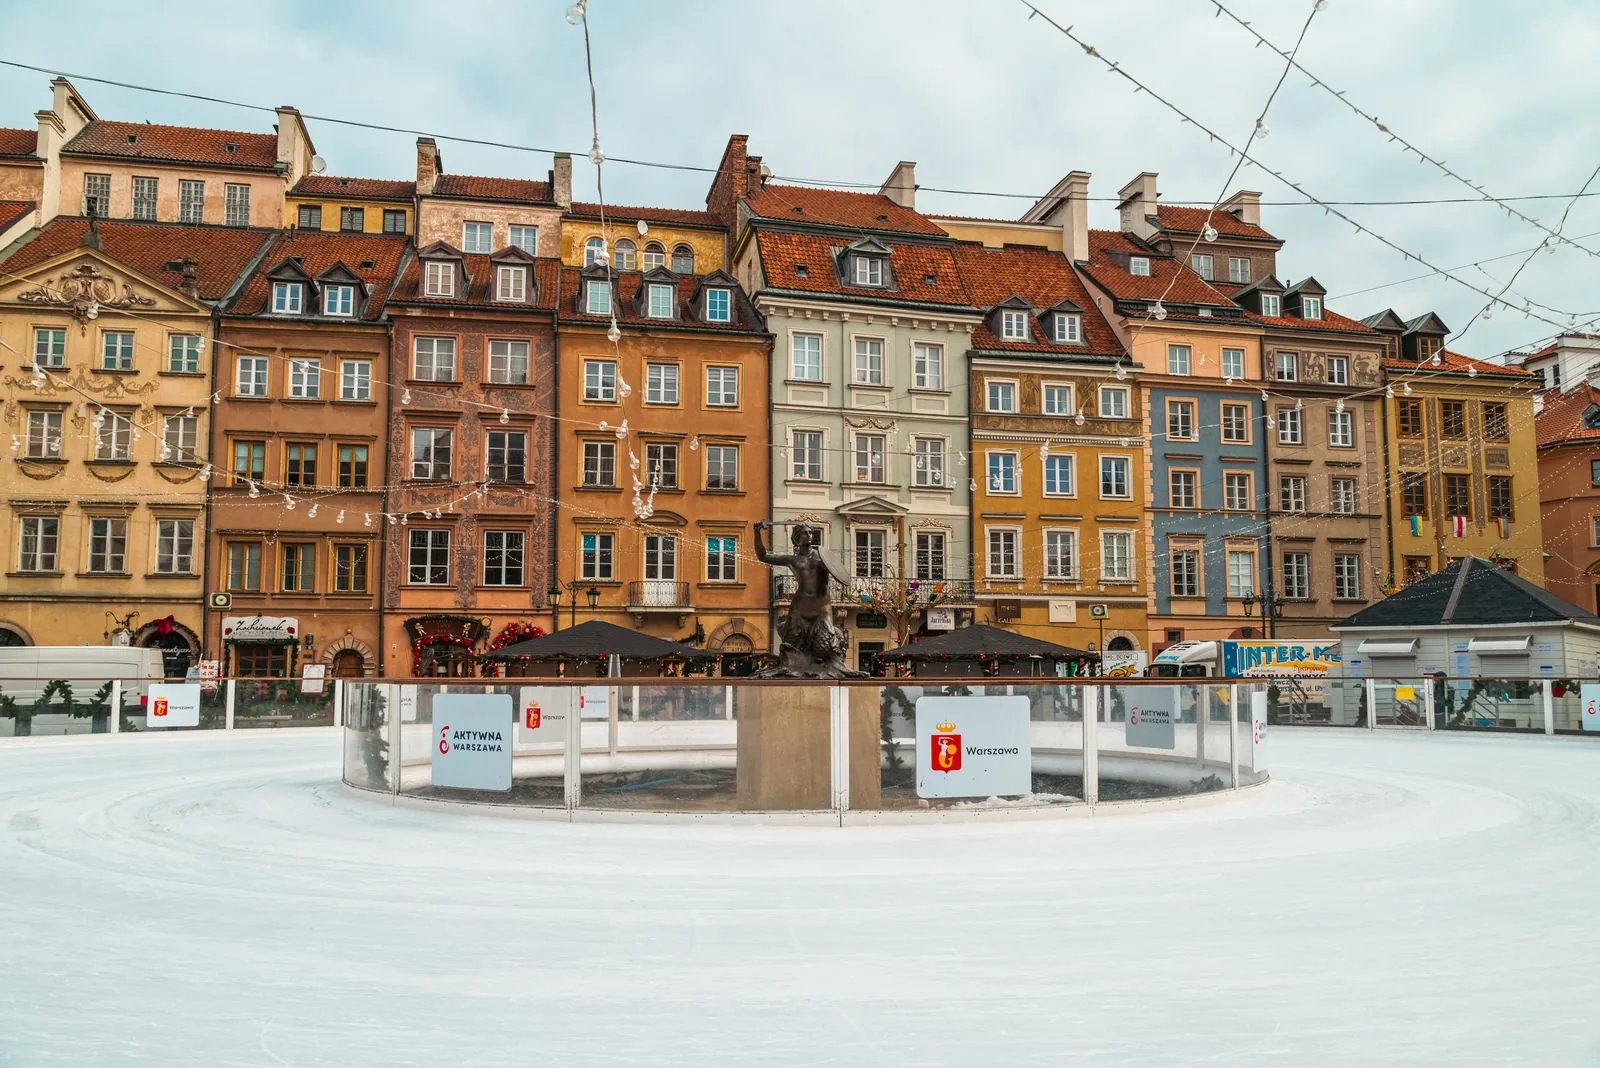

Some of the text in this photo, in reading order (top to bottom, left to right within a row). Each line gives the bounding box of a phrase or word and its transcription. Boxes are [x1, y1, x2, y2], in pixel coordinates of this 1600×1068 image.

[1140, 709, 1170, 718] AKTYWNA
[453, 730, 503, 741] AKTYWNA
[453, 742, 503, 752] WARSZAWA
[965, 746, 1019, 756] Warszawa
